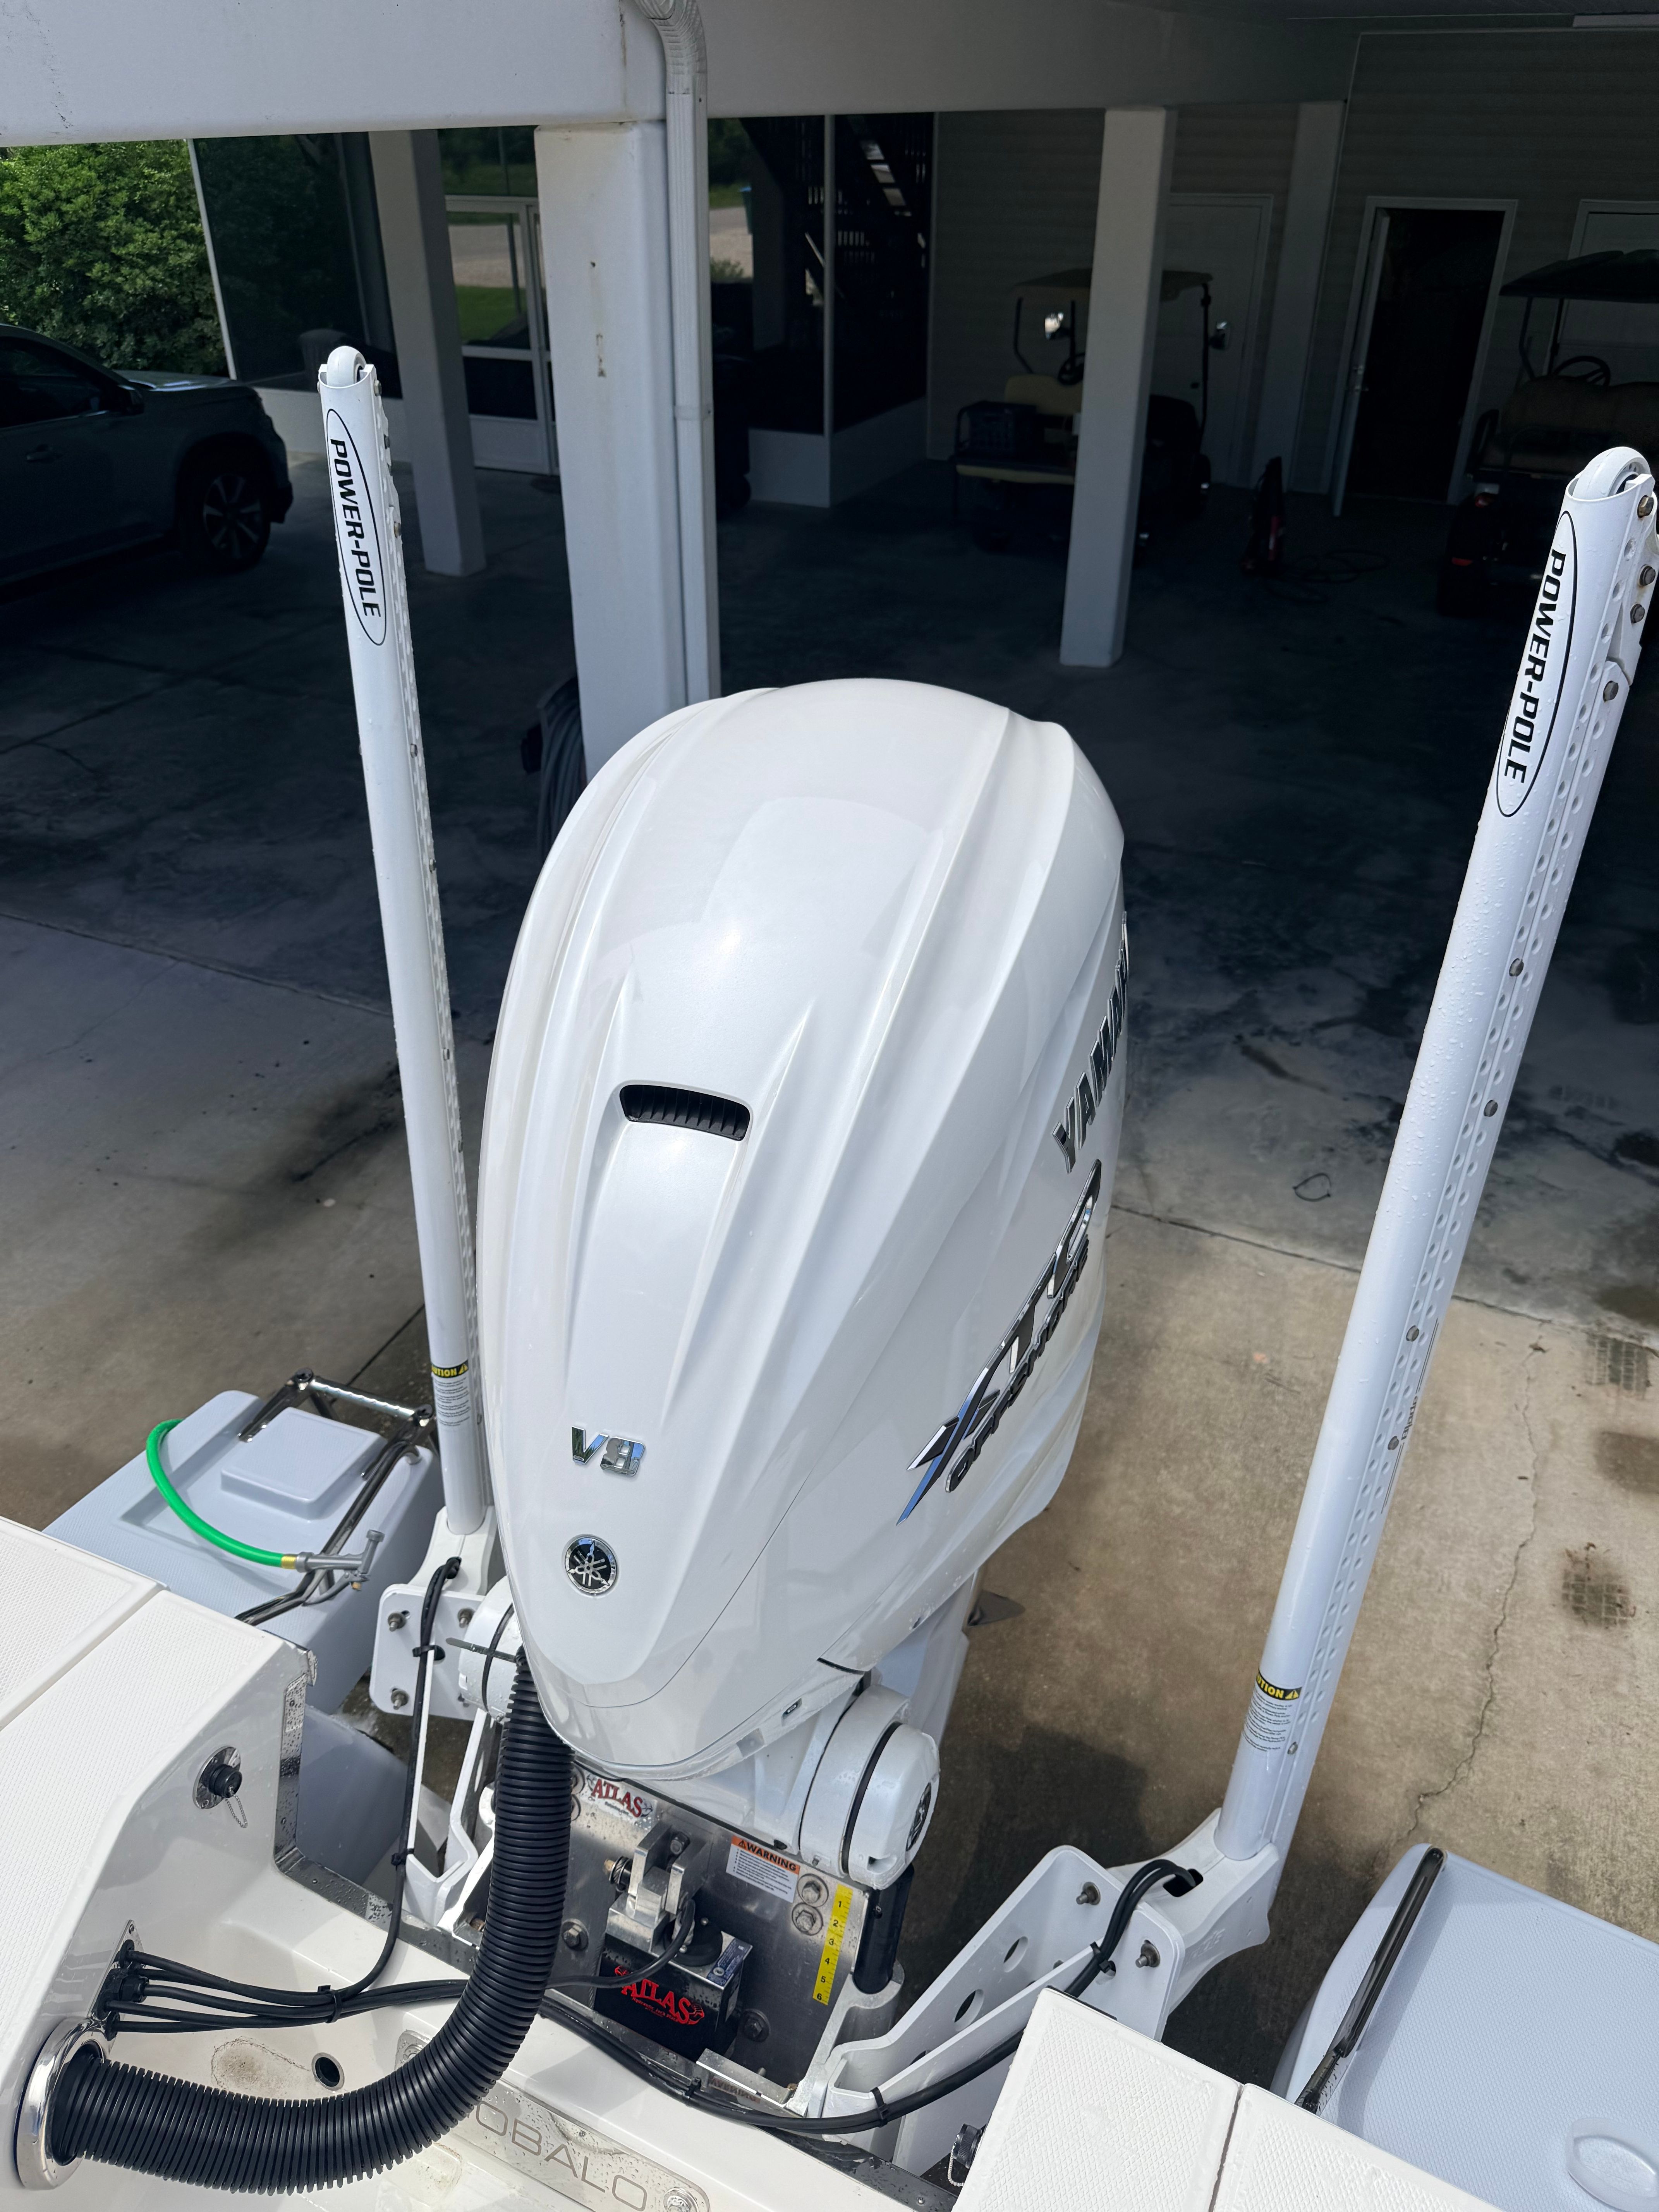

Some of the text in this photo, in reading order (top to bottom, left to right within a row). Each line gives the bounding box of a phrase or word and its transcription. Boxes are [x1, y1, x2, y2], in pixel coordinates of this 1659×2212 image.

[330, 438, 381, 618] POWER-POLE
[1504, 549, 1566, 784] POWER-POLE
[1052, 911, 1129, 1174] YAMAH
[571, 1426, 646, 1477] V8
[591, 1779, 643, 1818] ATLAS
[747, 1842, 797, 1872] WARNING
[476, 2100, 647, 2212] OBALO
